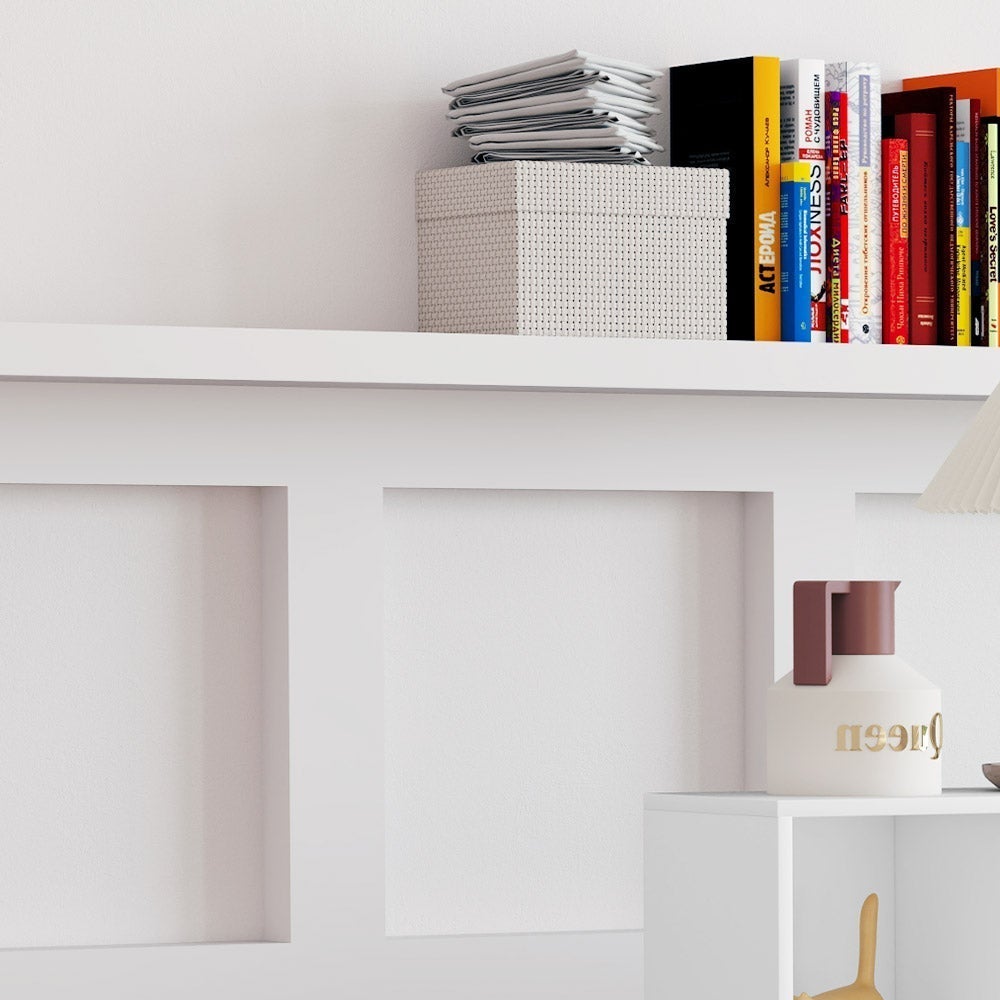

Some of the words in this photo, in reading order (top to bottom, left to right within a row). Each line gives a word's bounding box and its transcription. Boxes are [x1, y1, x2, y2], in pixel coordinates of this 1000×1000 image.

[813, 73, 822, 136] ЧУДОВИЩЕМ
[804, 109, 812, 143] РОМАН
[900, 154, 908, 184] СМЕРТИ
[891, 165, 900, 222] ПУТЕВОДИТЕЛЬ
[989, 206, 998, 242] Love's
[758, 211, 777, 294] АСТЕРОИД
[831, 238, 841, 277] Диета
[989, 245, 998, 283] Secret
